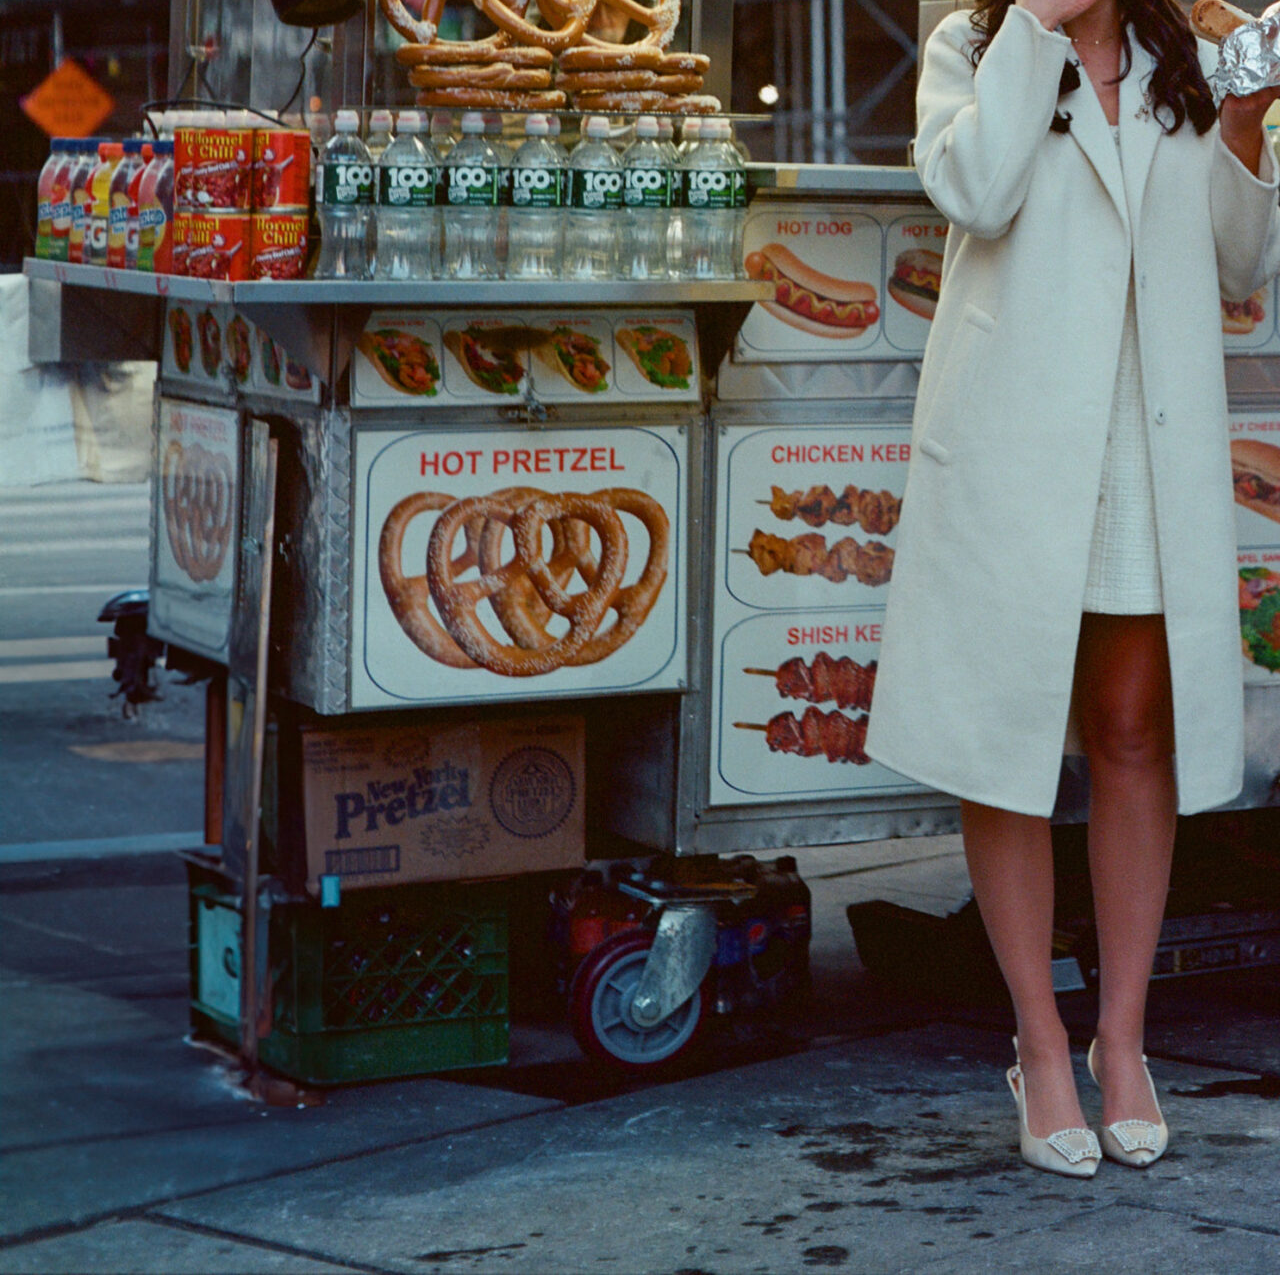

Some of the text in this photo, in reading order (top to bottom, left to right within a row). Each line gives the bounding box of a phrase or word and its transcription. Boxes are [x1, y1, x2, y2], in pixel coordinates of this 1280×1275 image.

[263, 231, 298, 245] Chili
[776, 220, 853, 236] HOT DOG
[902, 226, 930, 238] HOT
[419, 446, 626, 477] HOT PRETZEL
[771, 444, 864, 464] CHICKEN
[786, 625, 850, 646] SHISH
[334, 767, 472, 840] Pretzel
